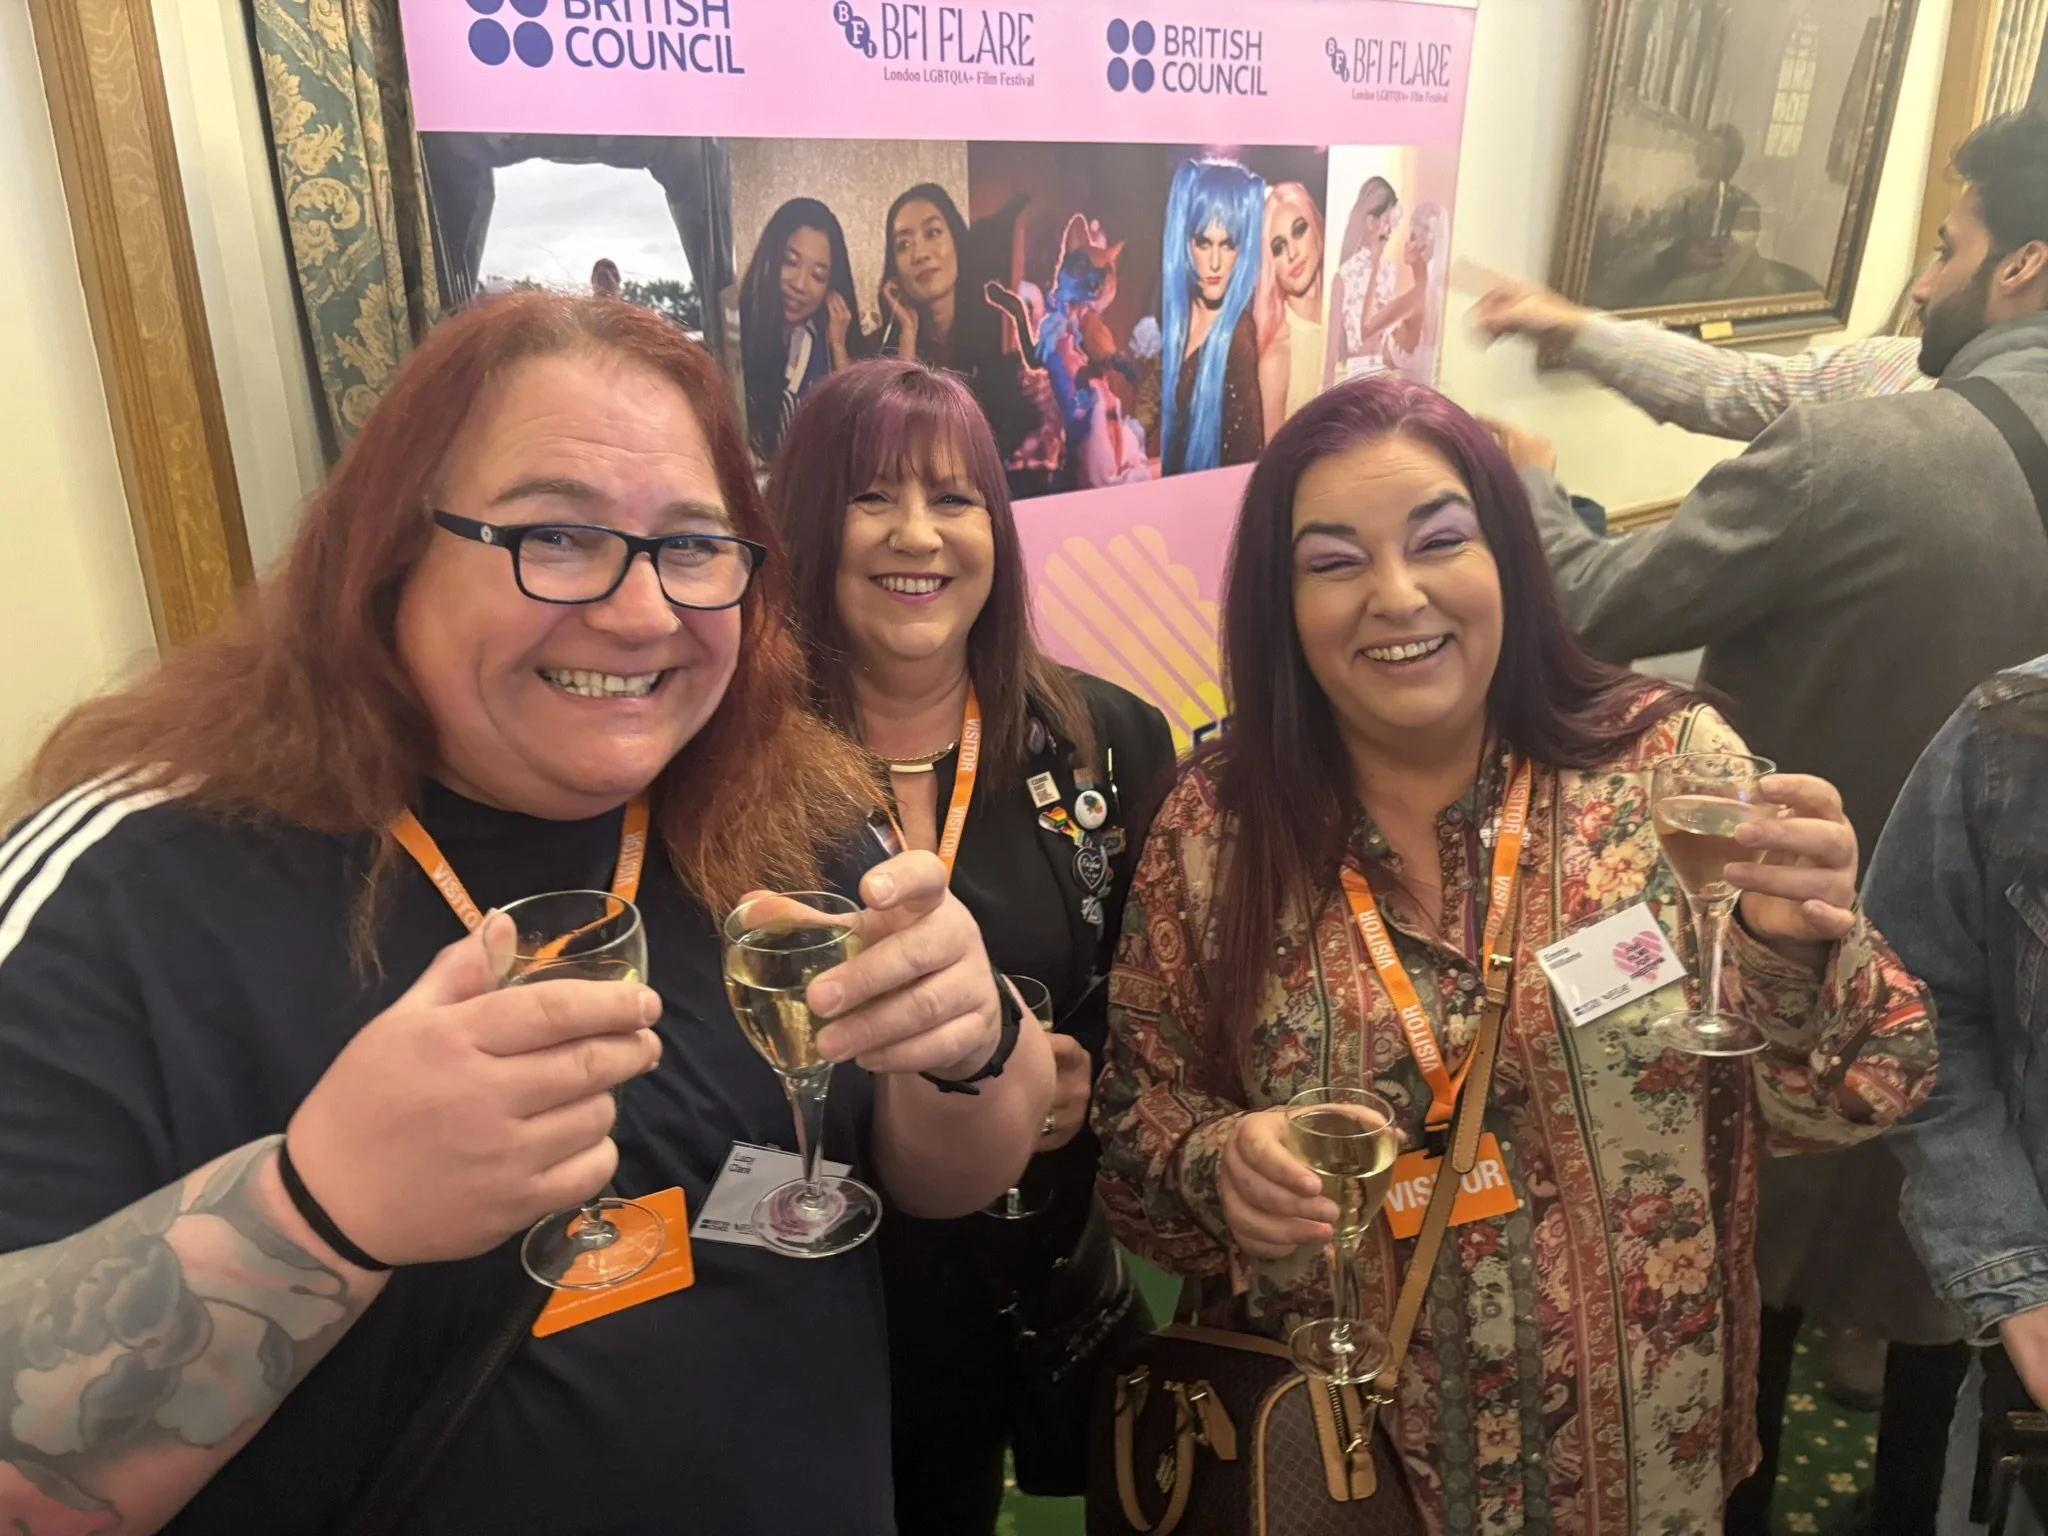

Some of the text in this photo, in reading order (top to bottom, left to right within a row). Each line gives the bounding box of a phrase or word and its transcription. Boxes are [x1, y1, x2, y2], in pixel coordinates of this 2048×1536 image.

[565, 26, 746, 74] COUNCIL
[881, 2, 1035, 67] BFI FLARE
[1164, 24, 1263, 61] BRITISH
[884, 66, 1035, 87] London LGBTQIA+ Film Festival
[1162, 61, 1268, 96] COUNCIL
[1353, 38, 1452, 87] BFI FLARE
[959, 718, 981, 773] VISITOR
[940, 805, 965, 858] VISITOR
[431, 860, 478, 928] VISITO
[1358, 910, 1397, 971] VISITOR
[1400, 1004, 1439, 1073] VISITOR
[1386, 1159, 1505, 1213] VISOR
